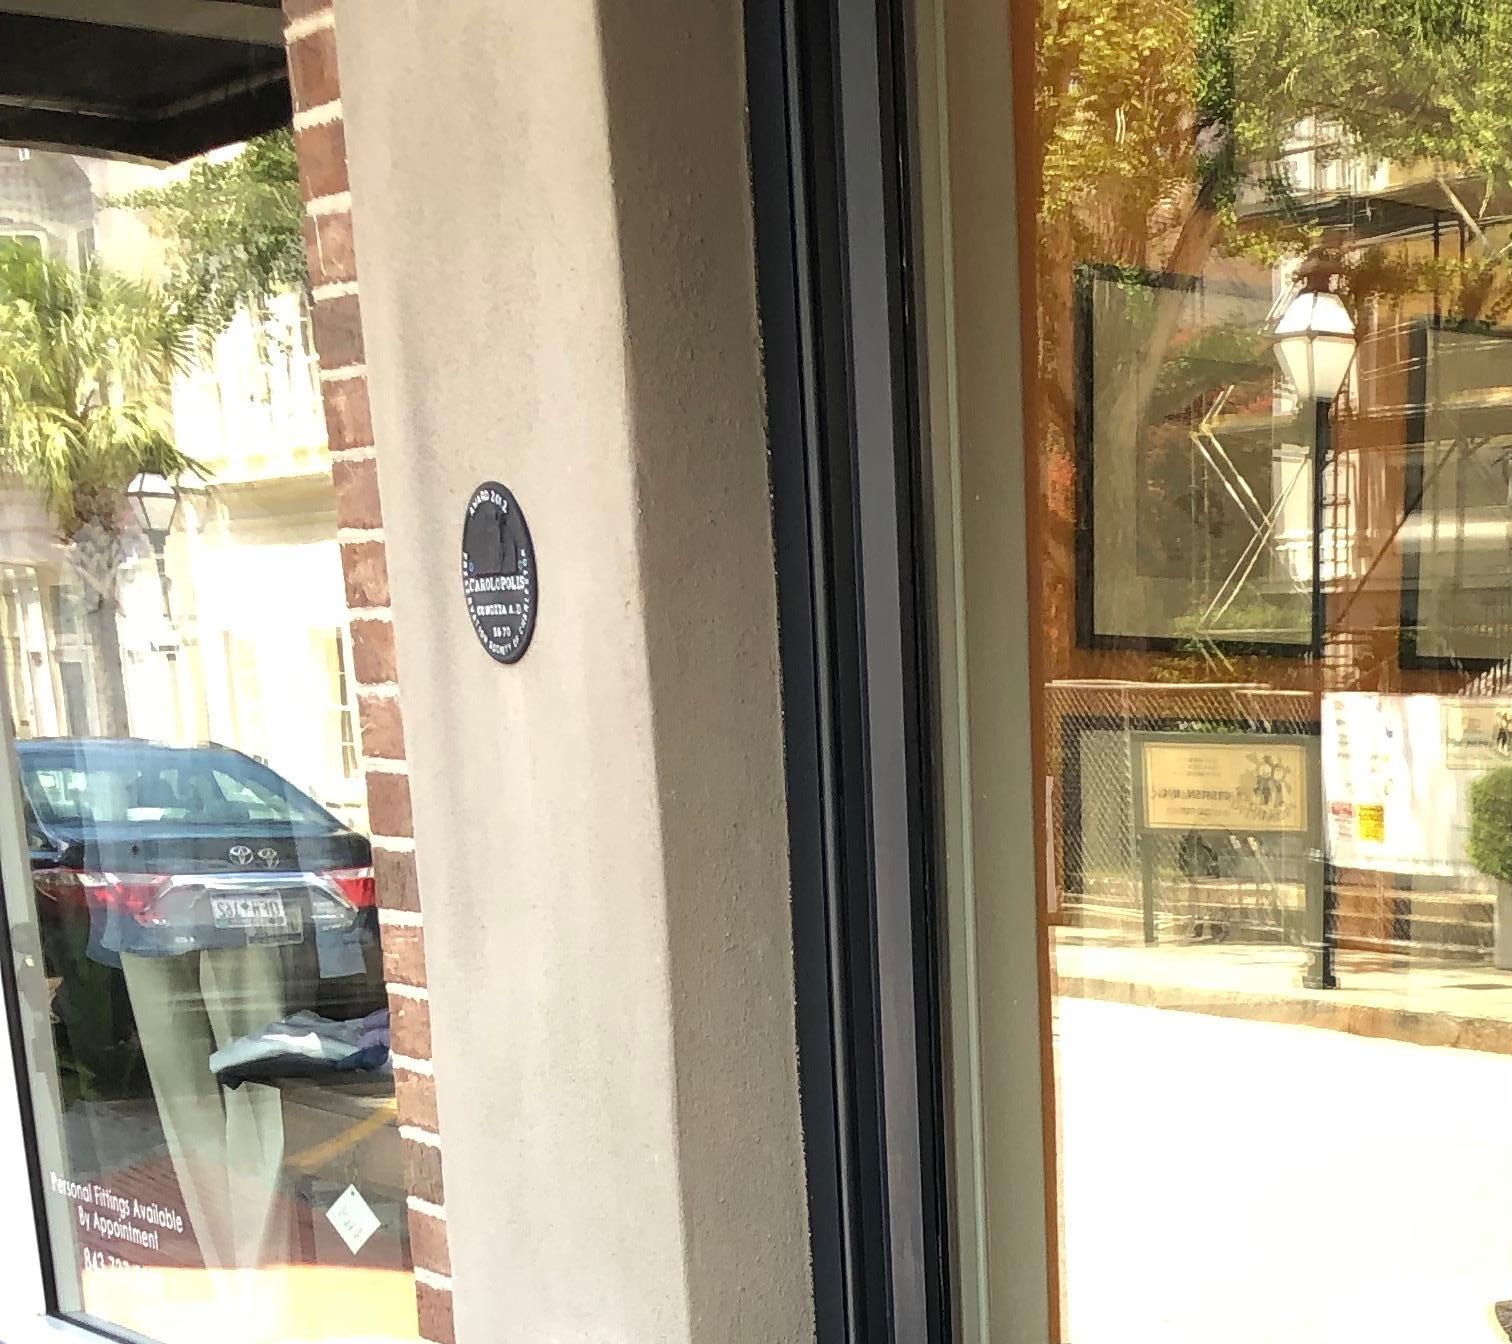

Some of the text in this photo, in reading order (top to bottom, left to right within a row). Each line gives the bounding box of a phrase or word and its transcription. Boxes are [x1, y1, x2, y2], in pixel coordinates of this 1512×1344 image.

[490, 490, 508, 514] 2012
[468, 575, 525, 592] CAROLOPOLIS
[50, 1171, 184, 1234] Personal Fittings Available
[78, 1206, 159, 1250] By Appointment
